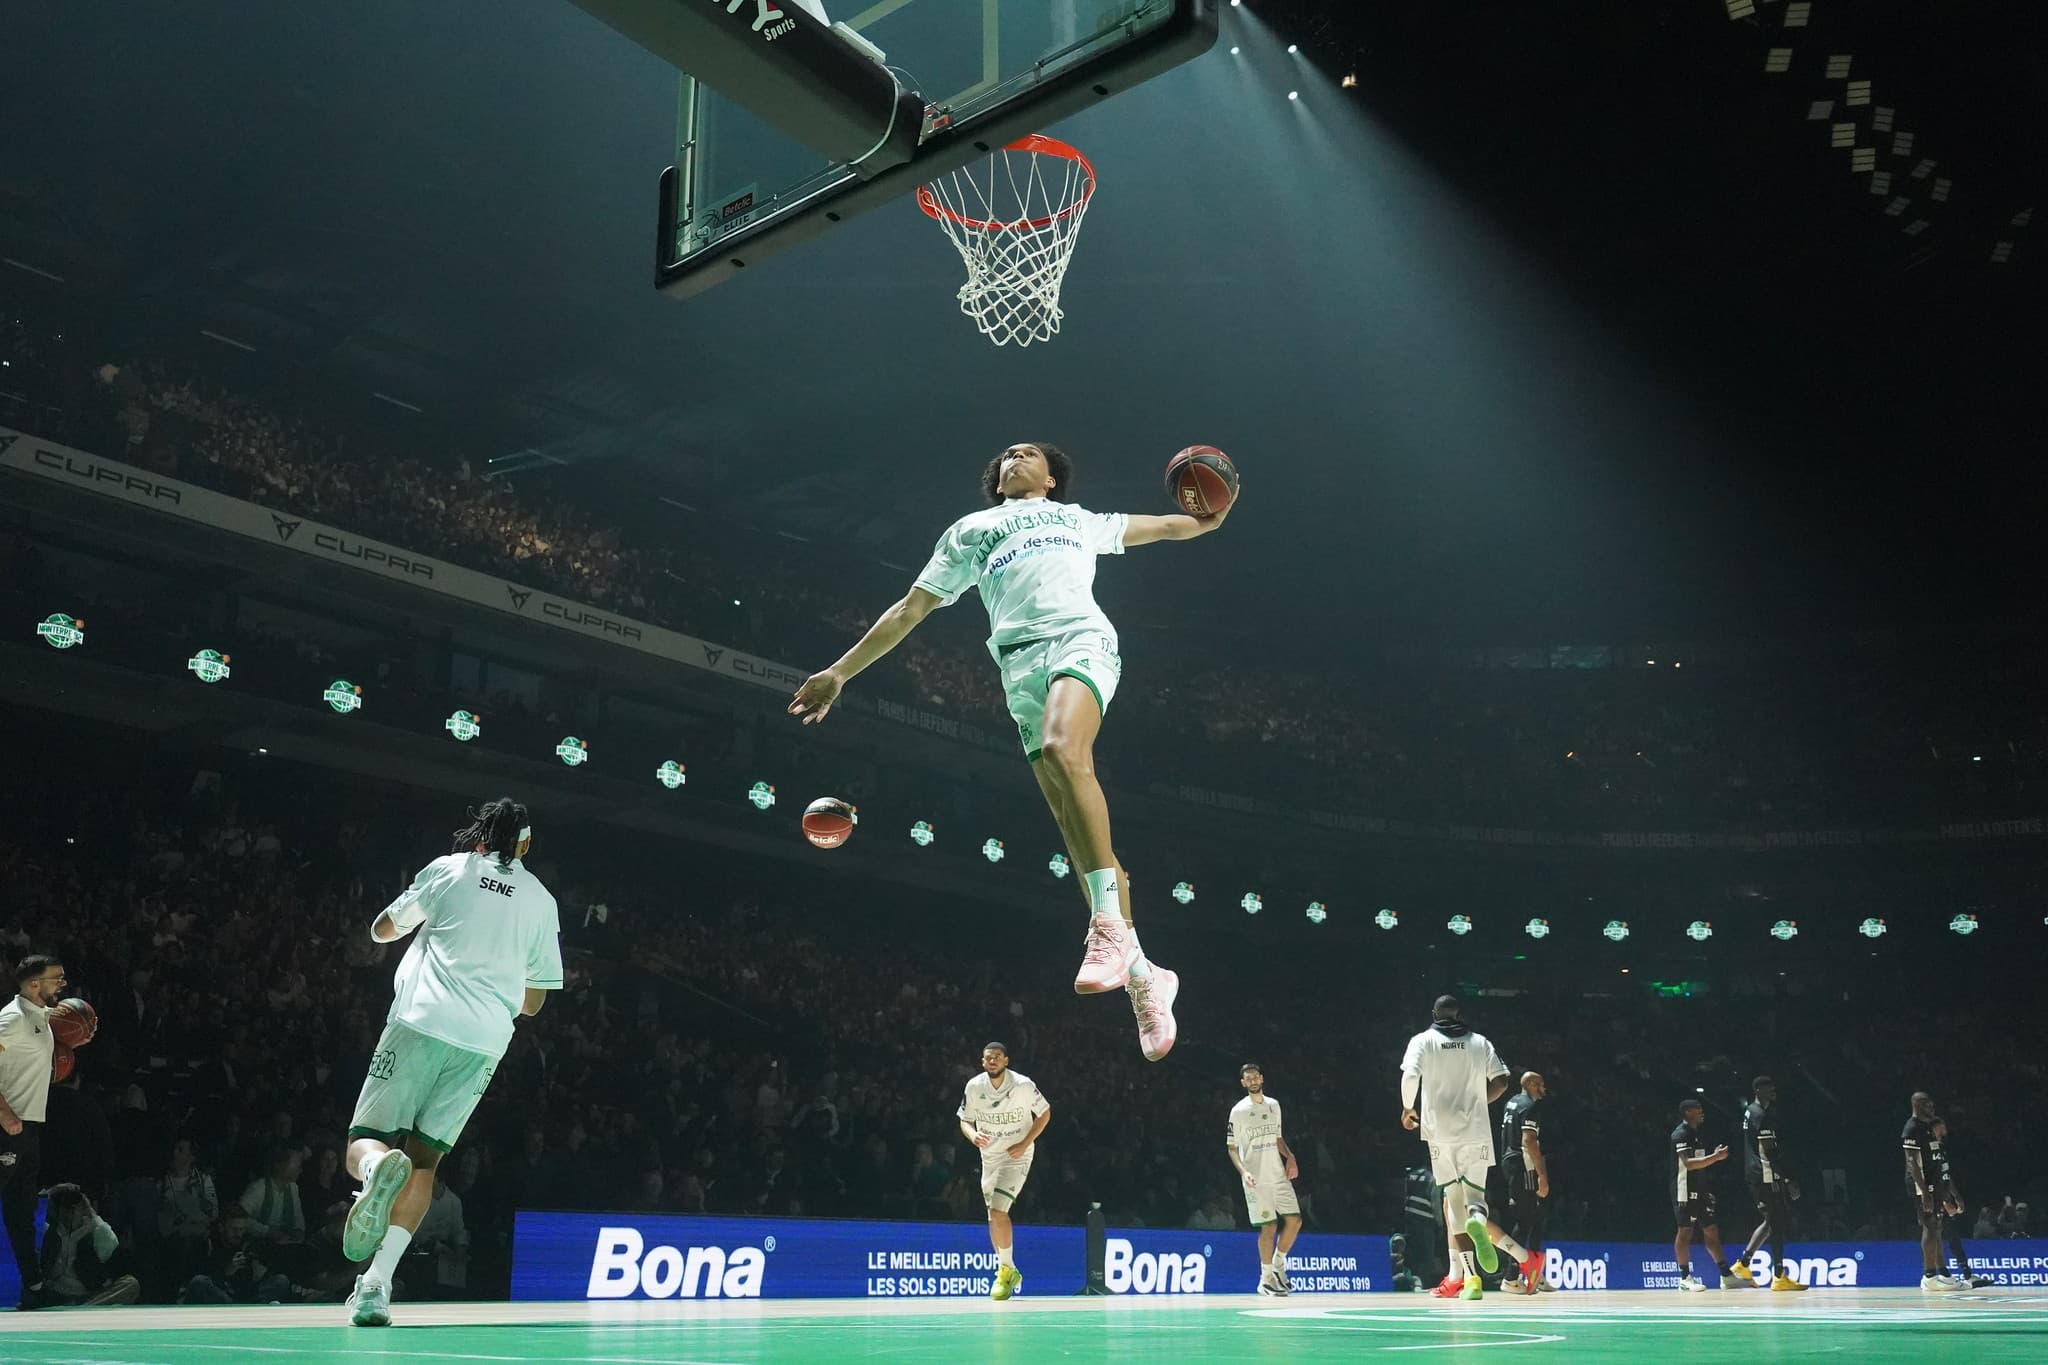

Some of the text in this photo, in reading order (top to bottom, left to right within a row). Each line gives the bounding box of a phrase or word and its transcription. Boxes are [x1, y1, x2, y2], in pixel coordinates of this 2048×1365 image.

[763, 18, 796, 41] Sports
[35, 450, 181, 504] CUPRA
[315, 533, 434, 579] CUPRA
[543, 602, 641, 641] CUPRA
[733, 659, 800, 686] CUPR
[479, 876, 516, 898] SENE
[868, 1252, 886, 1269] LE
[890, 1252, 960, 1270] MEILLEUR
[1284, 1256, 1357, 1271] MEILLEUR POUR
[868, 1277, 989, 1295] LES SOLS DEPUIS
[1290, 1276, 1371, 1291] SOLS DEPUIS 1919
